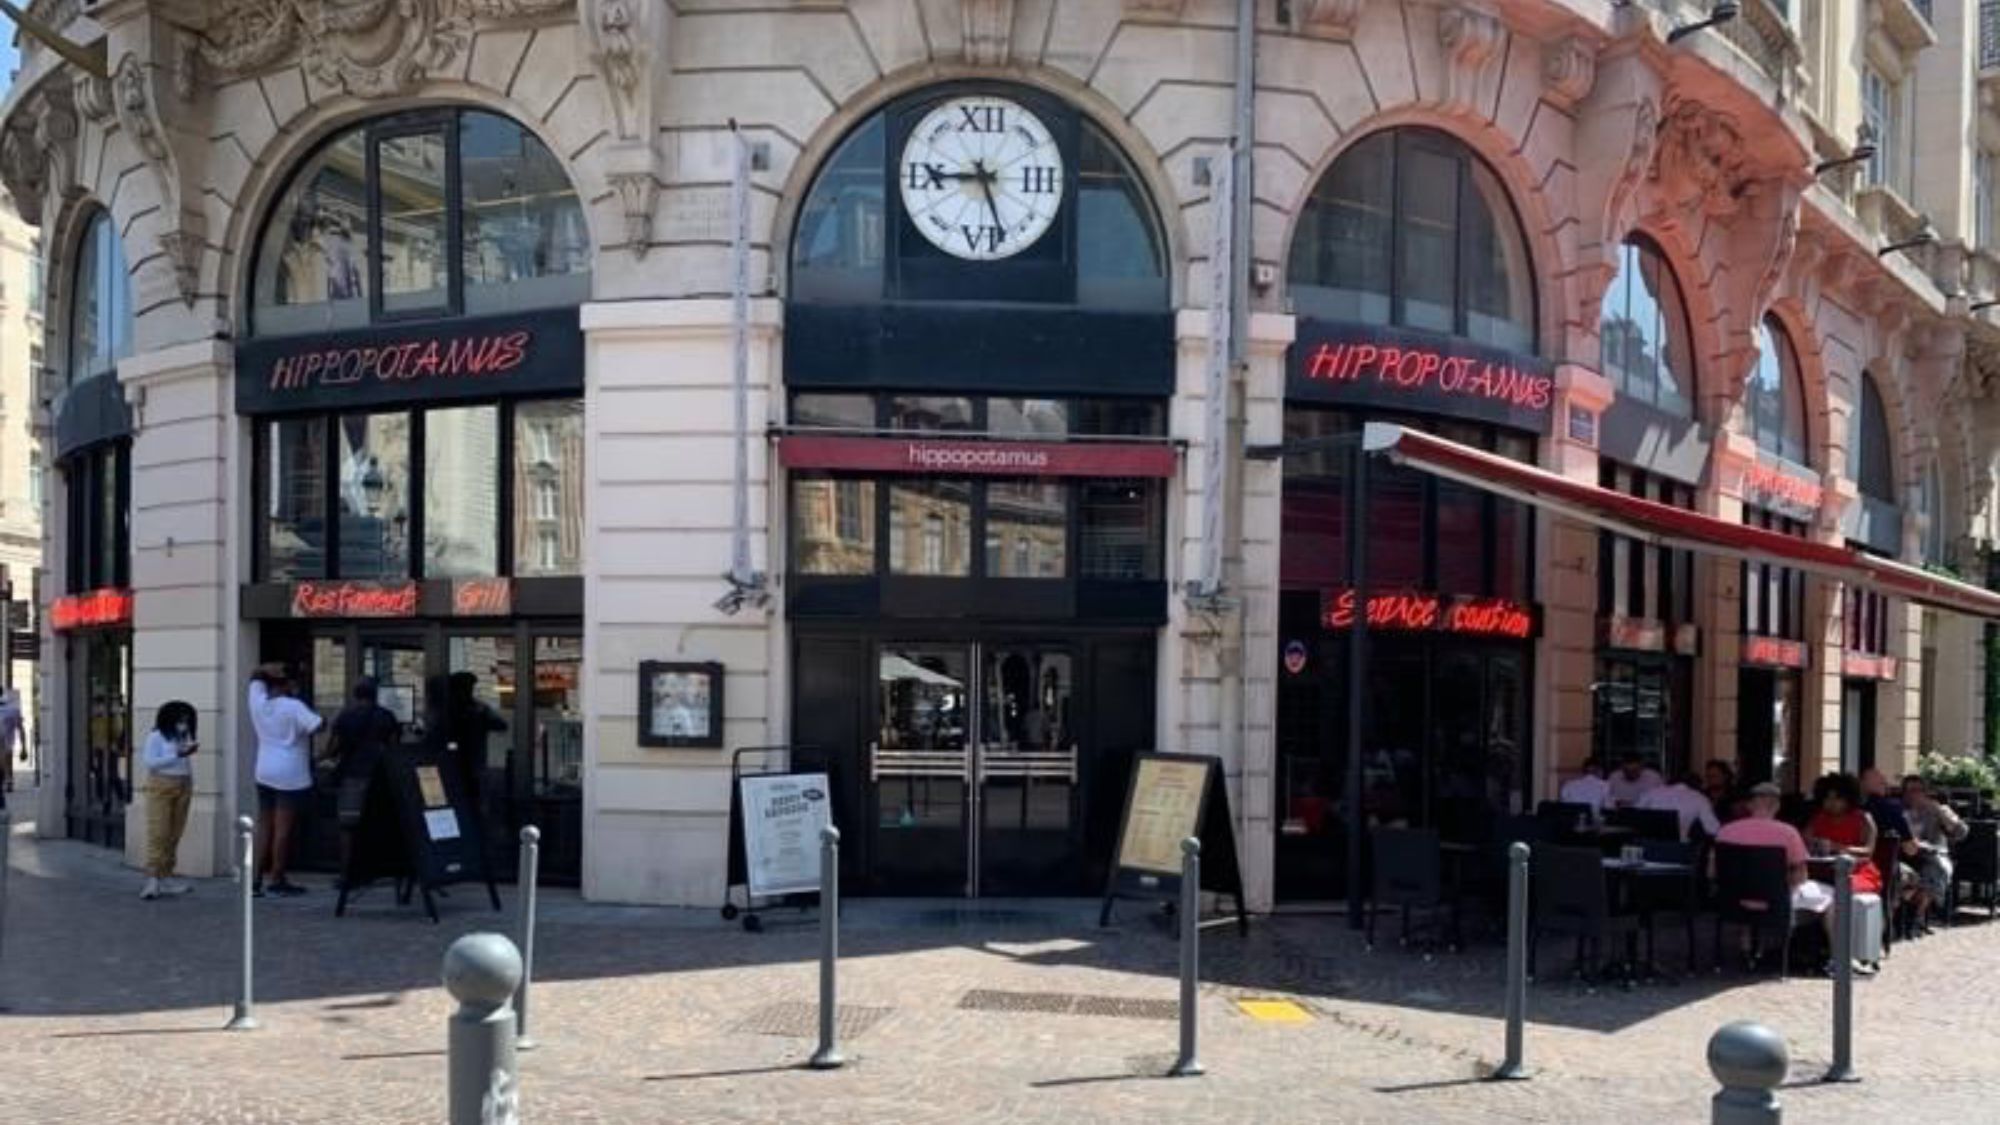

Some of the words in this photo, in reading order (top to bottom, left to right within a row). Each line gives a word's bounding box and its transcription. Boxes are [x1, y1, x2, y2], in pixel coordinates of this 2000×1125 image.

[958, 105, 1006, 133] XII
[909, 162, 945, 190] IX
[1022, 166, 1056, 193] III
[960, 225, 999, 252] VI
[269, 331, 529, 390] HIPPOPOTAMUS
[1309, 343, 1552, 409] HIPPOPOTAMUS
[909, 443, 1048, 468] hippopotamus
[456, 581, 511, 613] Grill
